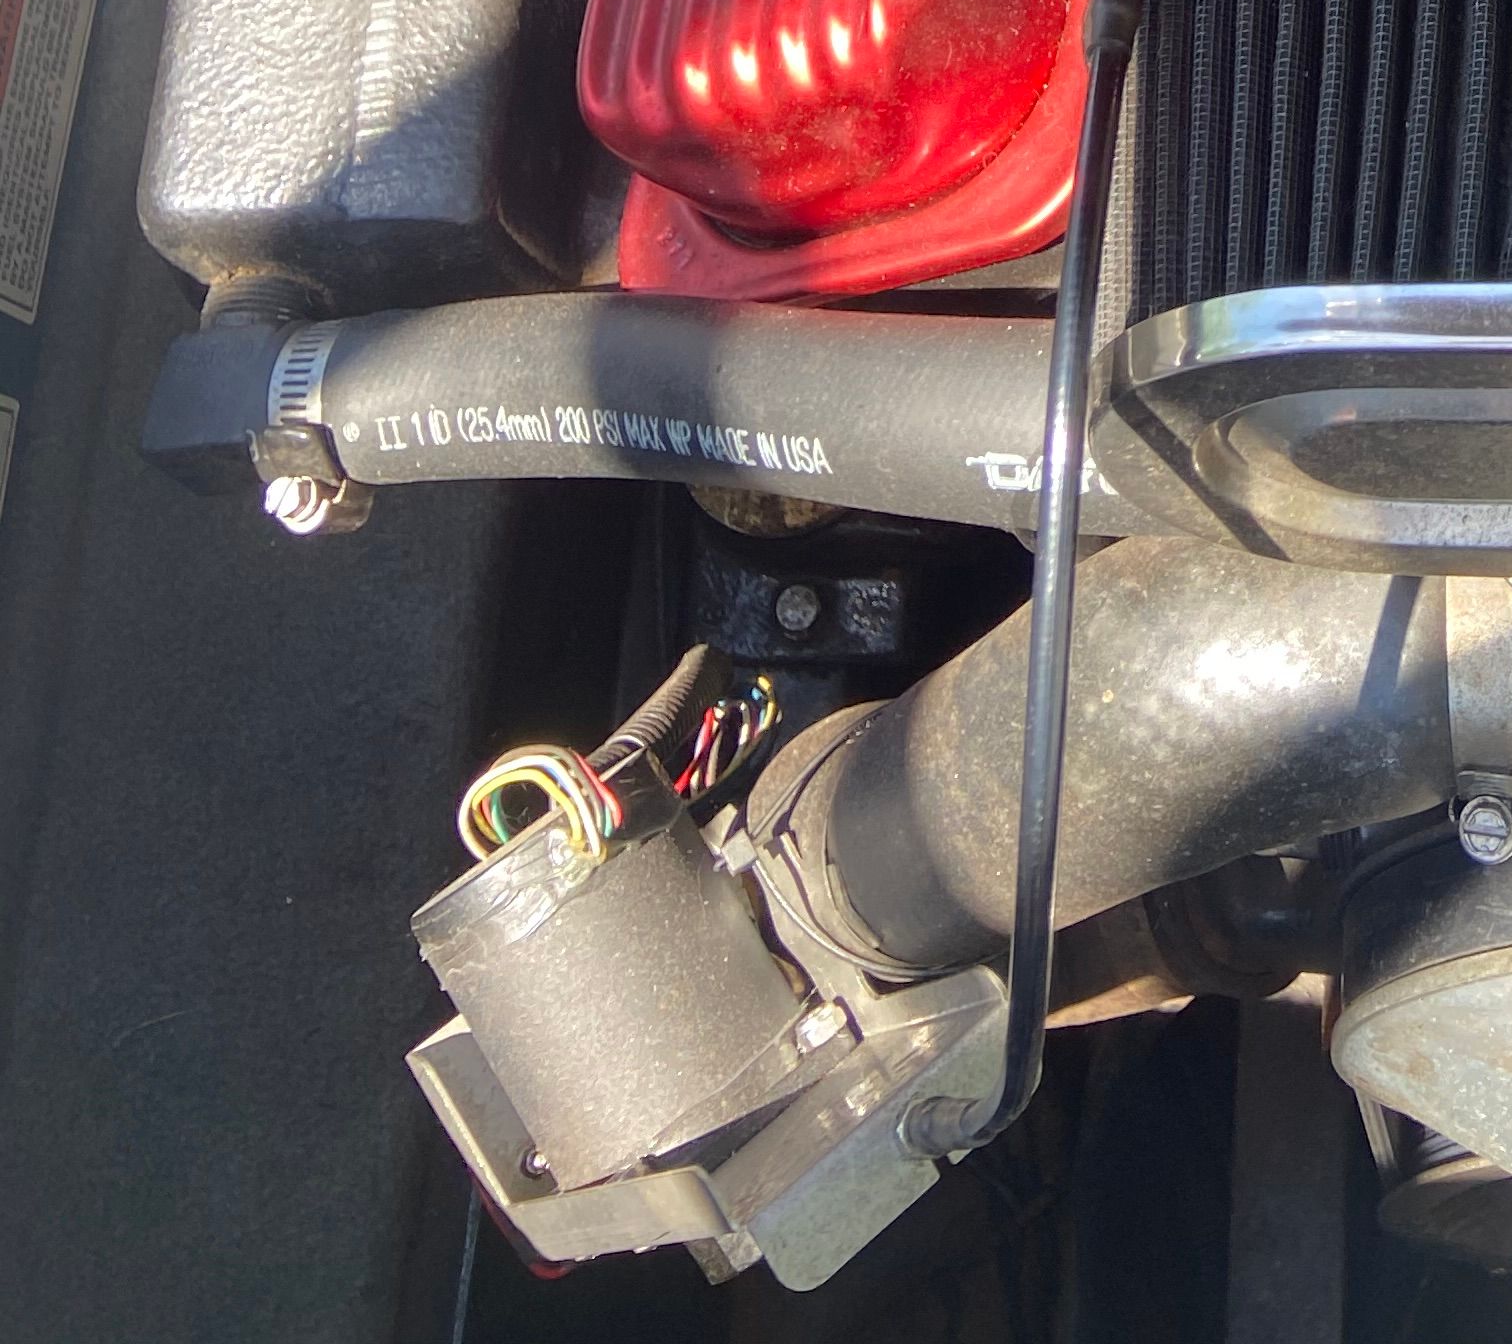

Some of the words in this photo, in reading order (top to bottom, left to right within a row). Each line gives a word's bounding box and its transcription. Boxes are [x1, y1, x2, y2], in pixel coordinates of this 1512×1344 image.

[457, 405, 552, 443] (25.4mm)
[555, 406, 590, 444] 200
[593, 409, 624, 447] PSI
[624, 411, 666, 452] MAX
[665, 418, 692, 456] WP
[696, 423, 756, 467] MADE
[757, 431, 783, 470] IN
[782, 435, 833, 475] USA
